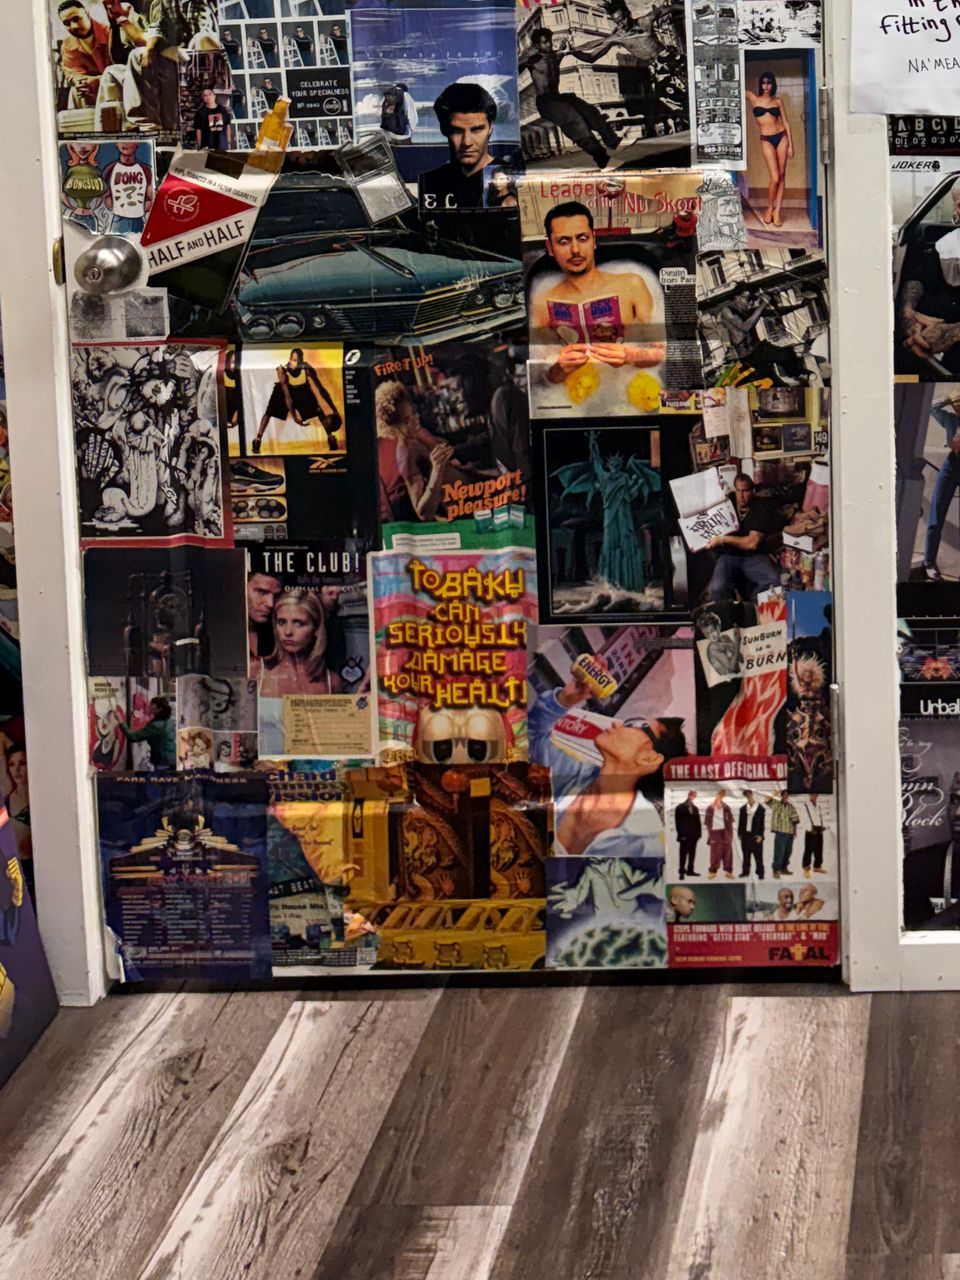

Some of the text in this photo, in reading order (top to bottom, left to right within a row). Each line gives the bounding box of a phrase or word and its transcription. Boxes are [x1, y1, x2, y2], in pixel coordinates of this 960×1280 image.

[892, 161, 931, 169] JOKER
[114, 171, 143, 186] BONG
[187, 171, 208, 185] TOBACCO
[218, 181, 233, 194] FILTER
[232, 187, 258, 203] CIGARETTE
[540, 180, 609, 198] Leaders
[624, 192, 703, 213] Nu Skool
[148, 219, 246, 269] HALF AND HALF
[660, 269, 686, 278] Dimitri
[661, 276, 679, 284] from
[442, 469, 522, 503] Newport
[447, 488, 526, 521] pleasure!
[263, 552, 360, 572] THE CLUB!
[742, 630, 782, 646] SUNBURN
[745, 652, 787, 670] BURN
[577, 656, 617, 689] ENERGY
[670, 761, 770, 779] THE LAST OFFICIAL
[768, 943, 829, 961] FATAL
